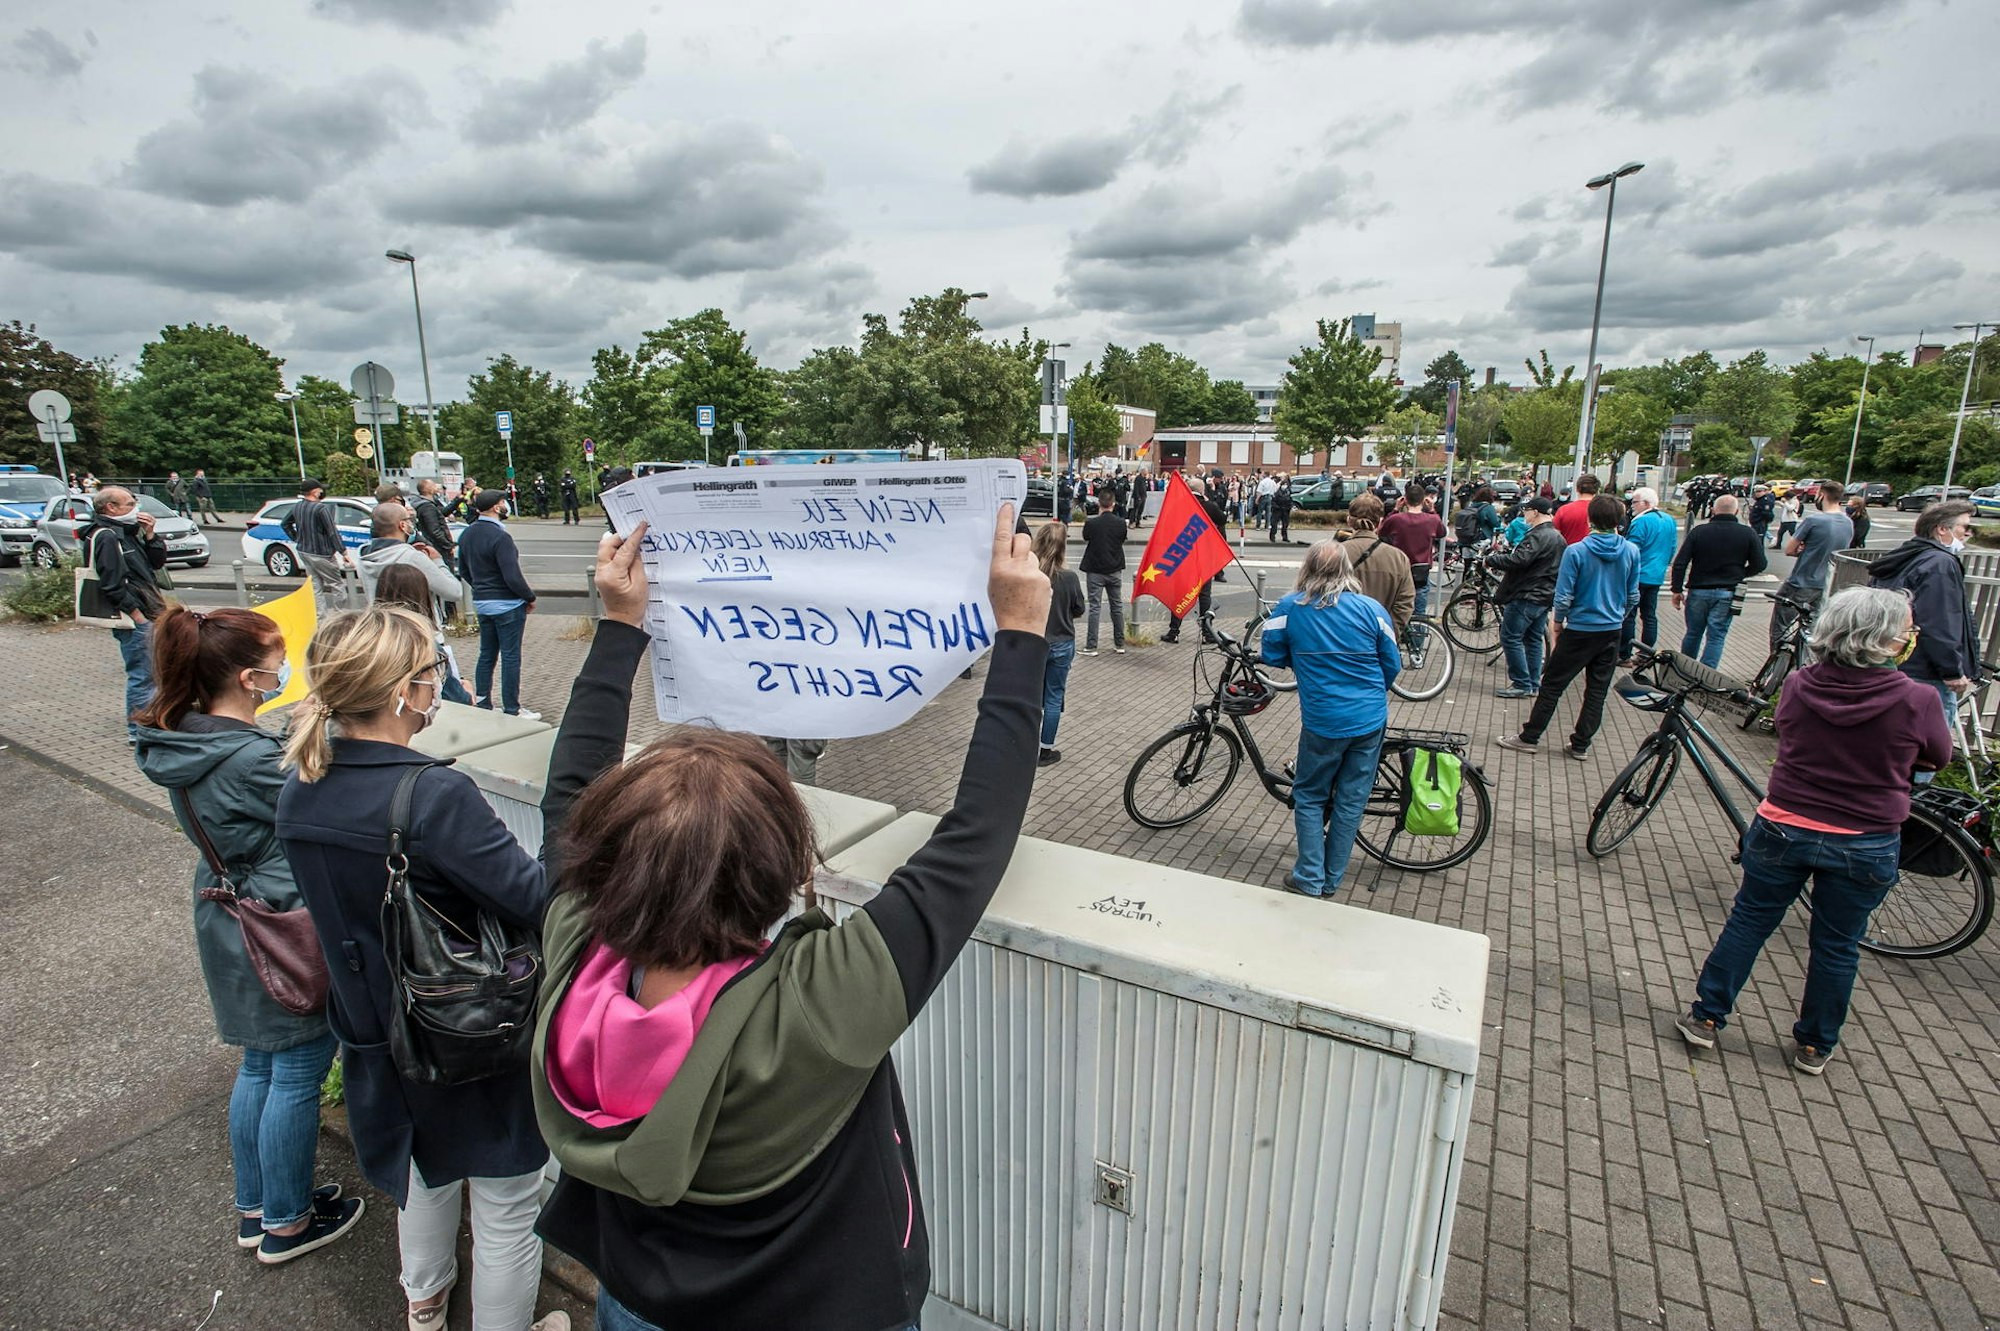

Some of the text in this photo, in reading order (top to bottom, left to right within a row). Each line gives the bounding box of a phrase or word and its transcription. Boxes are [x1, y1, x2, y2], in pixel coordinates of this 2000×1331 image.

[693, 480, 758, 492] Hellingrath
[823, 478, 857, 487] GIWEP
[878, 476, 931, 488] Hellingrath
[943, 476, 966, 484] Otto
